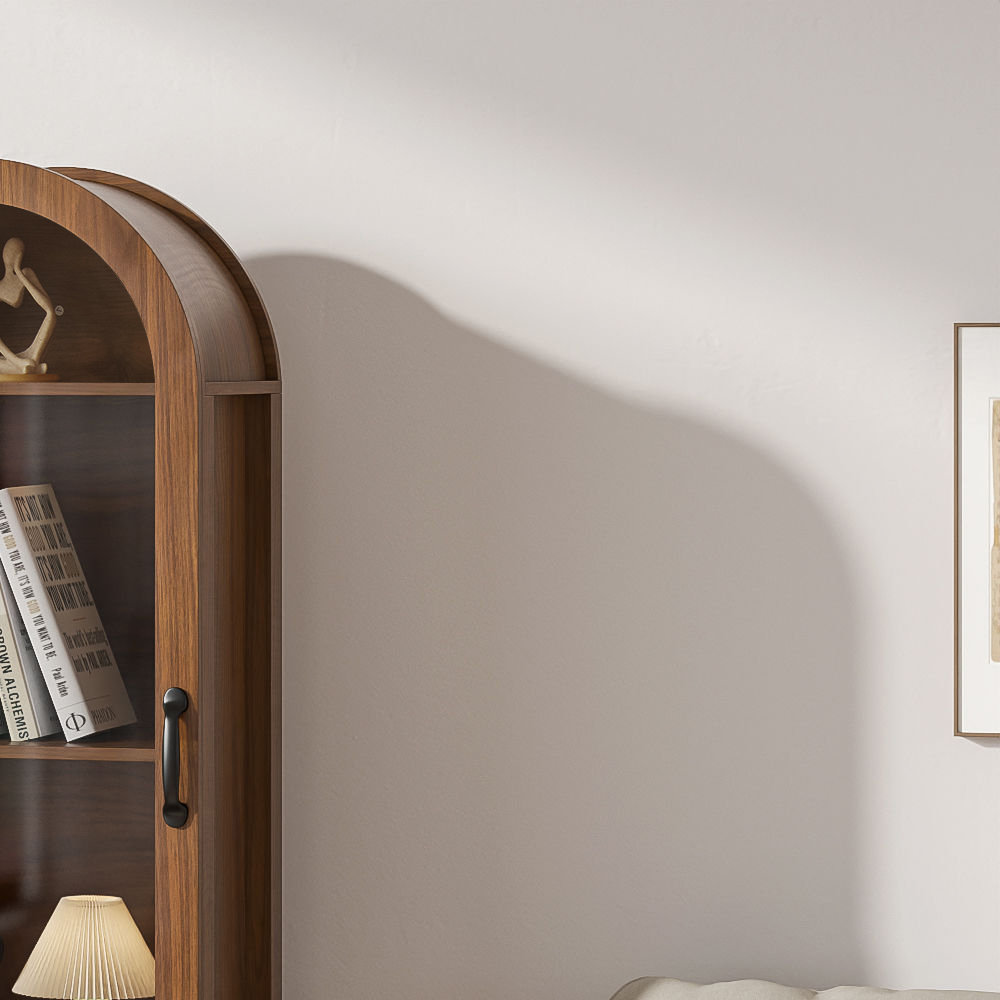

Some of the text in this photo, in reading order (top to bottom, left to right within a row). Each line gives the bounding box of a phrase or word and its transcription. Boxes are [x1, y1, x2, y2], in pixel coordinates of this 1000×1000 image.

[9, 549, 22, 562] YOU
[18, 574, 31, 587] IT'S
[21, 586, 36, 600] HOW
[32, 614, 46, 627] YOU
[37, 626, 51, 643] WANT
[42, 642, 55, 651] TO
[51, 667, 69, 698] Paul Arden
[5, 678, 30, 740] ALCHEMIS
